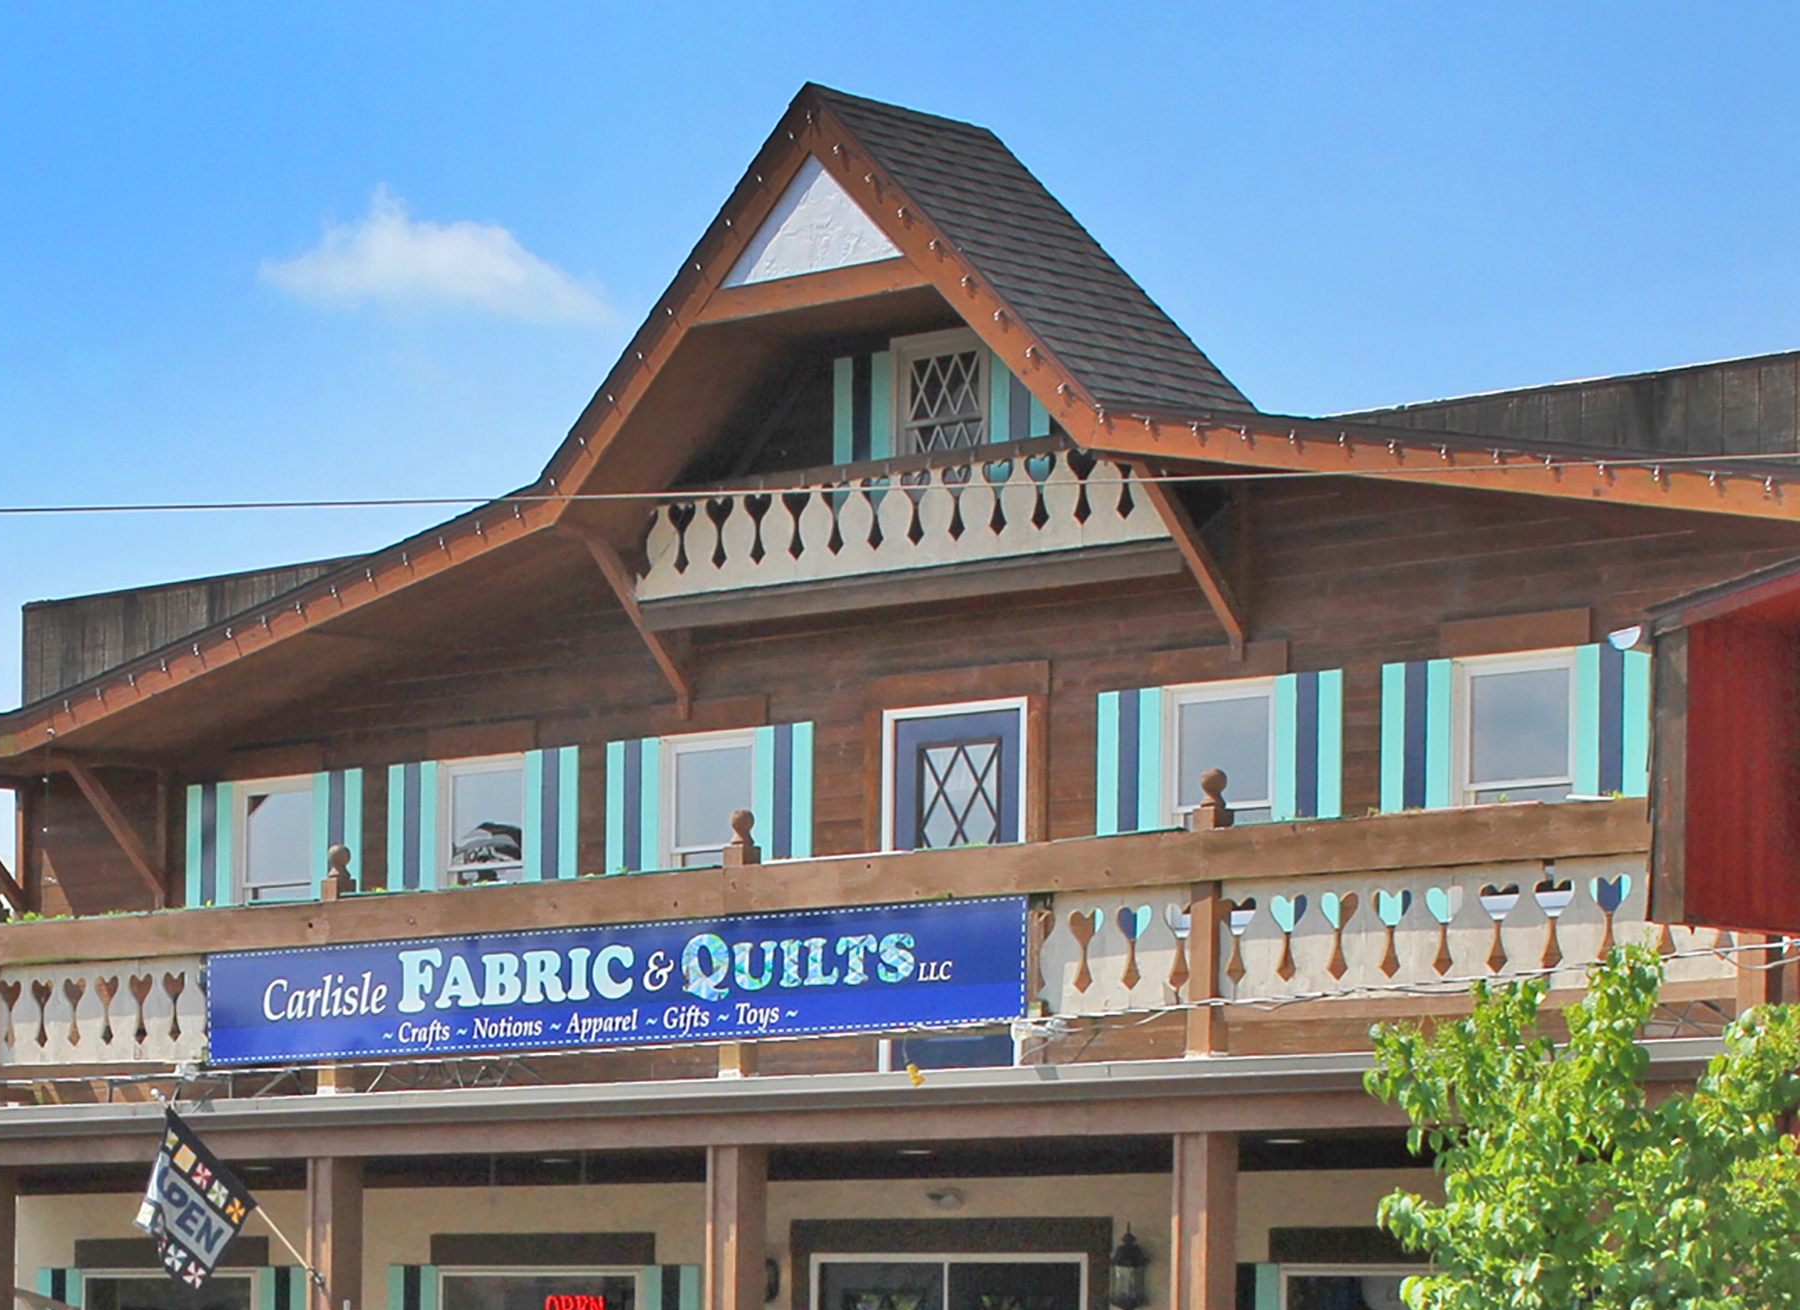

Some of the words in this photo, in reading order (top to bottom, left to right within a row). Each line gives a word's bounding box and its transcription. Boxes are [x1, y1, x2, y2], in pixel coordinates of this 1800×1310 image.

[262, 970, 388, 1022] Carlisle
[397, 943, 636, 1014] FABRIC
[642, 950, 675, 992] &
[681, 932, 917, 1002] QUILTS
[917, 961, 954, 982] LLC
[397, 1021, 451, 1051] Crafts
[471, 1016, 543, 1040] Notions
[565, 1008, 639, 1037] Apparel
[662, 1005, 711, 1036] Gifts
[735, 1002, 780, 1032] Toys
